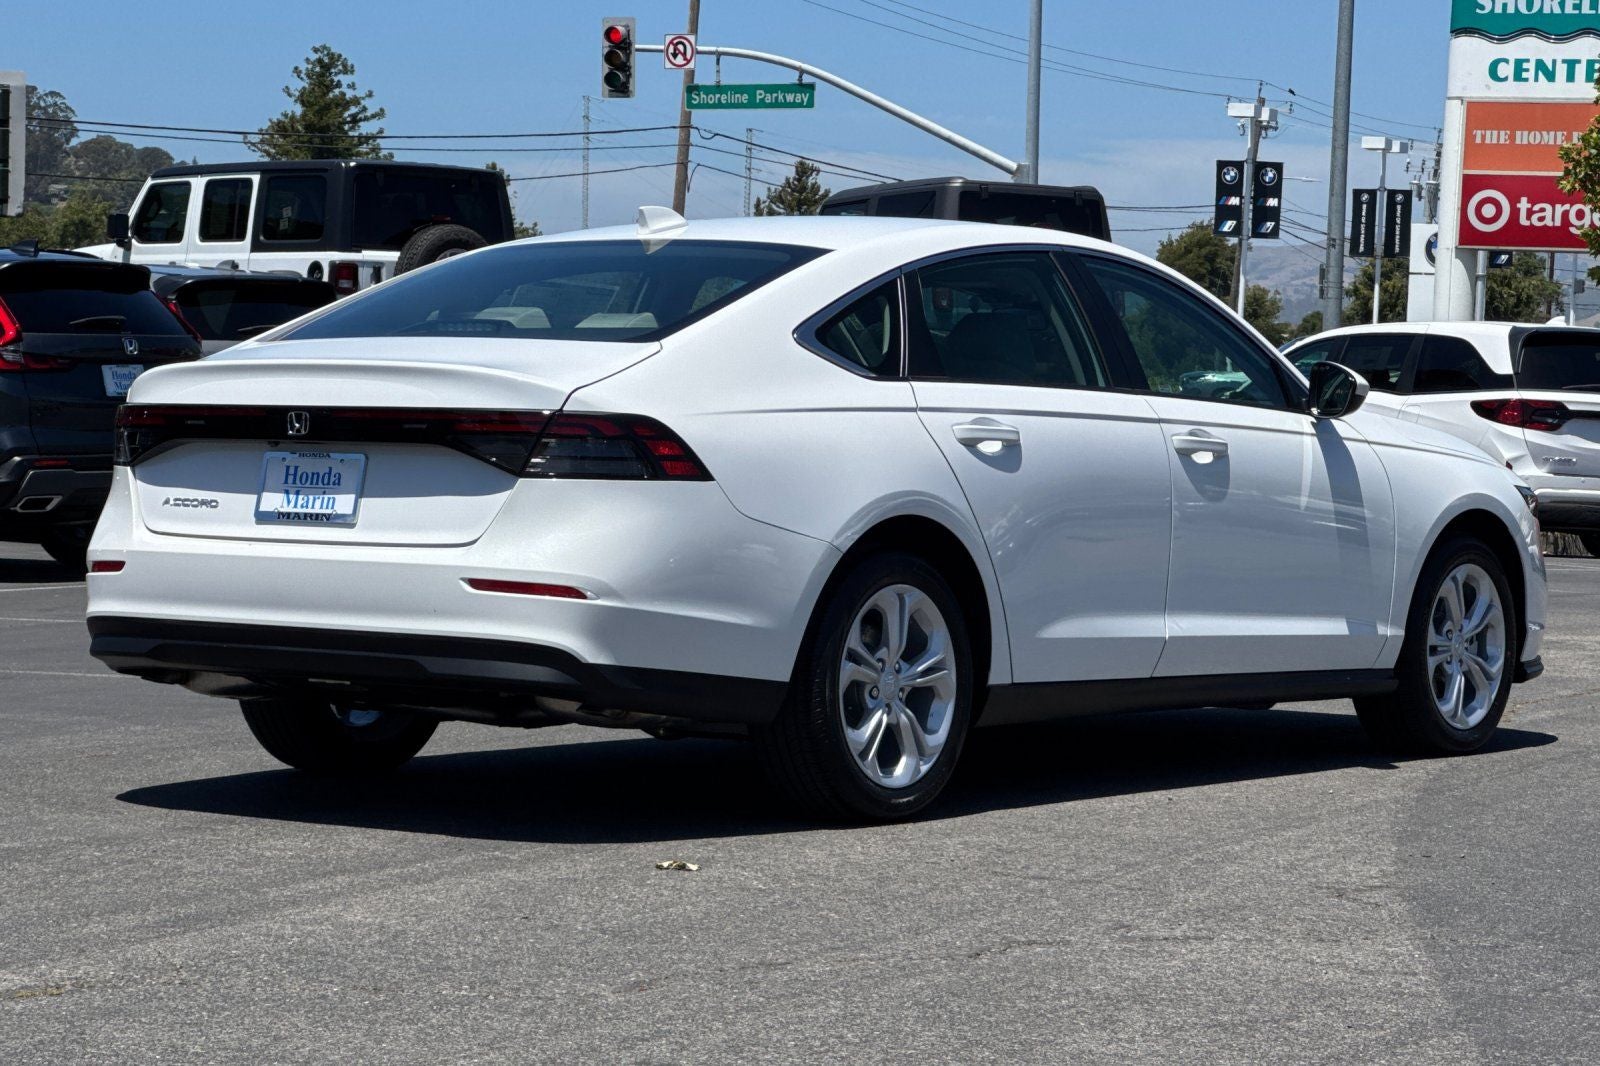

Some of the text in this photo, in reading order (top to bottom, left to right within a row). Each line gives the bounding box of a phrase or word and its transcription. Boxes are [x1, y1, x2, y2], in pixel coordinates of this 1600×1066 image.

[1475, 0, 1600, 14] SHOREL
[691, 90, 809, 105] Shoreline Parkway
[1473, 130, 1510, 144] THE
[1515, 131, 1567, 145] HOME
[282, 465, 341, 486] Honda
[162, 497, 219, 508] ACCORD
[281, 488, 336, 510] Marin
[277, 511, 332, 521] MARIN
